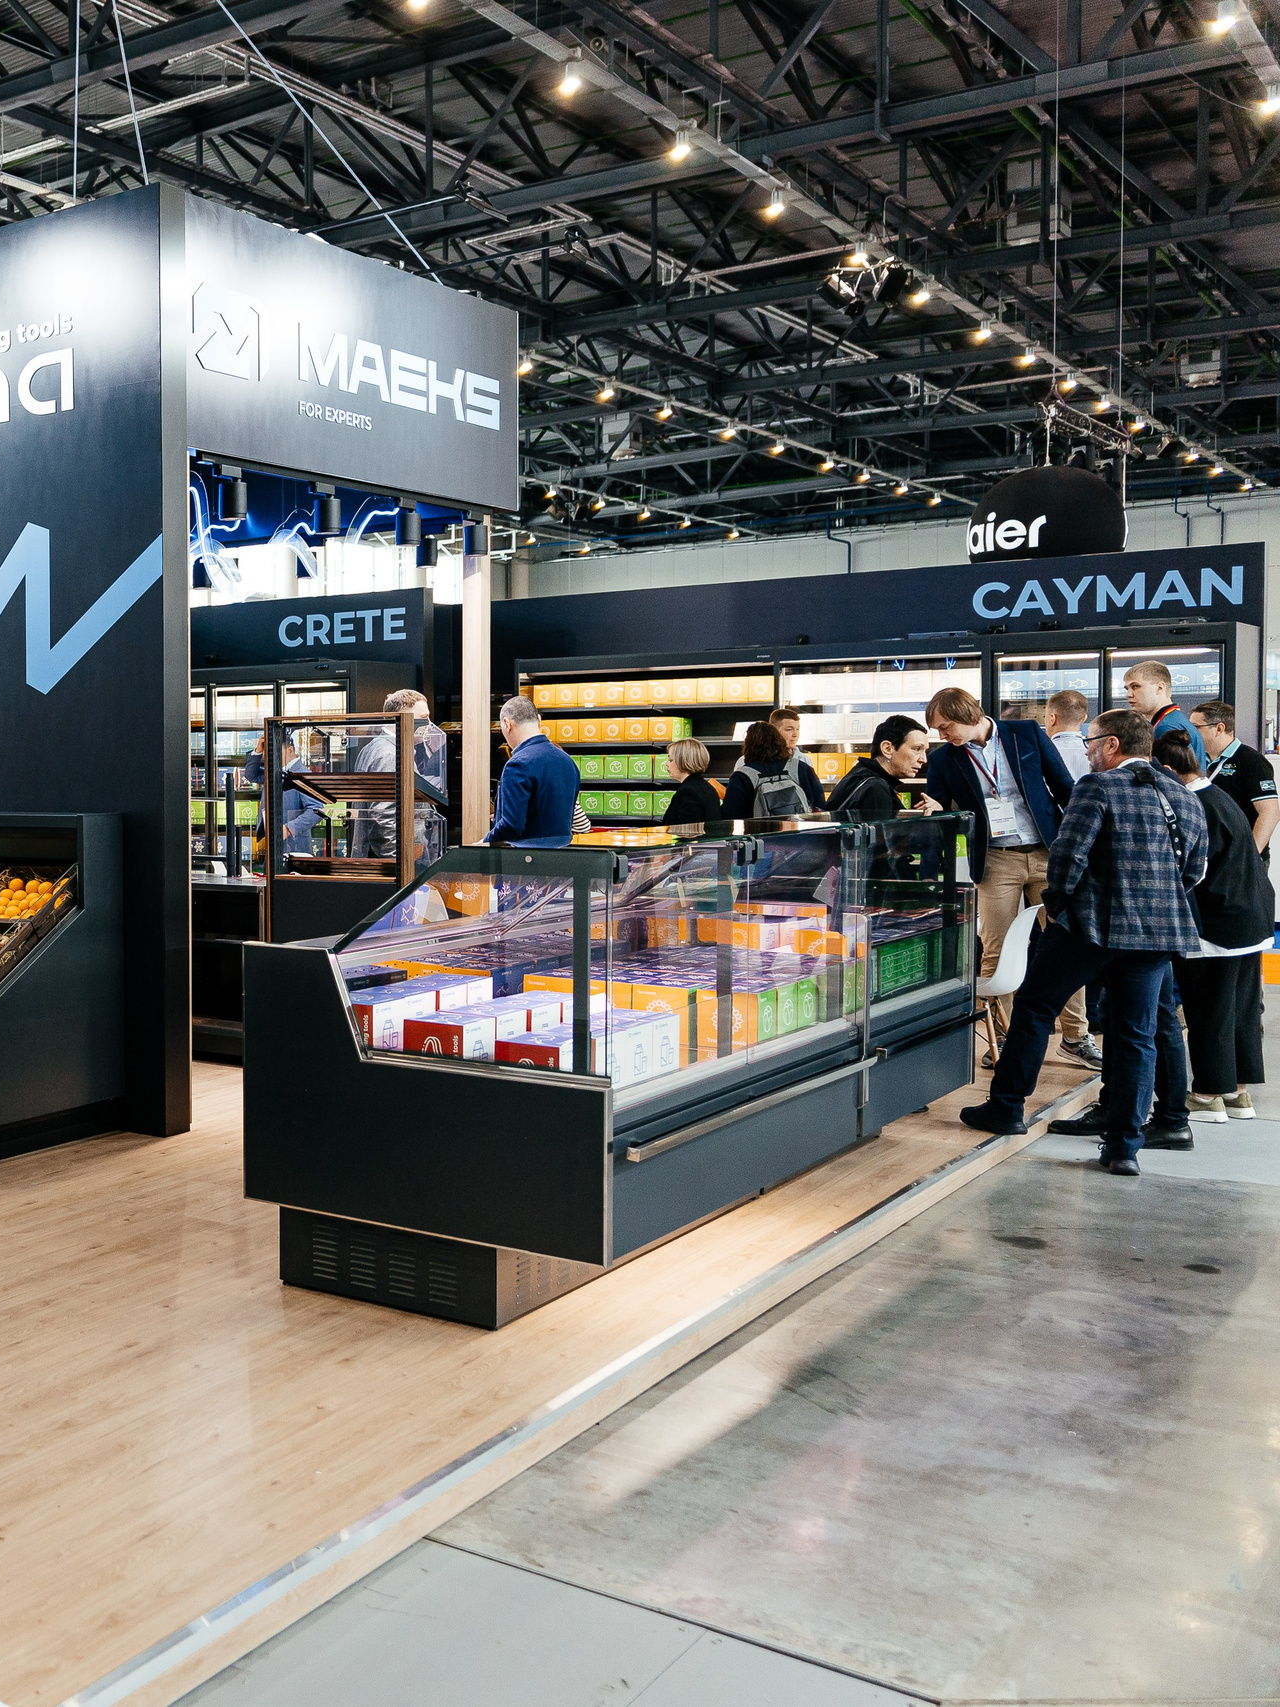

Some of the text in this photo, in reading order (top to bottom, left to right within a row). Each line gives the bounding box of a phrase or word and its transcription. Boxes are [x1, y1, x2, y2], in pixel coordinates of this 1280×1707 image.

[16, 313, 74, 343] tools
[297, 321, 500, 431] MAEKS
[298, 400, 372, 431] FOR EXPERTS
[972, 565, 1244, 619] CAYMAN
[278, 607, 407, 648] CRETE
